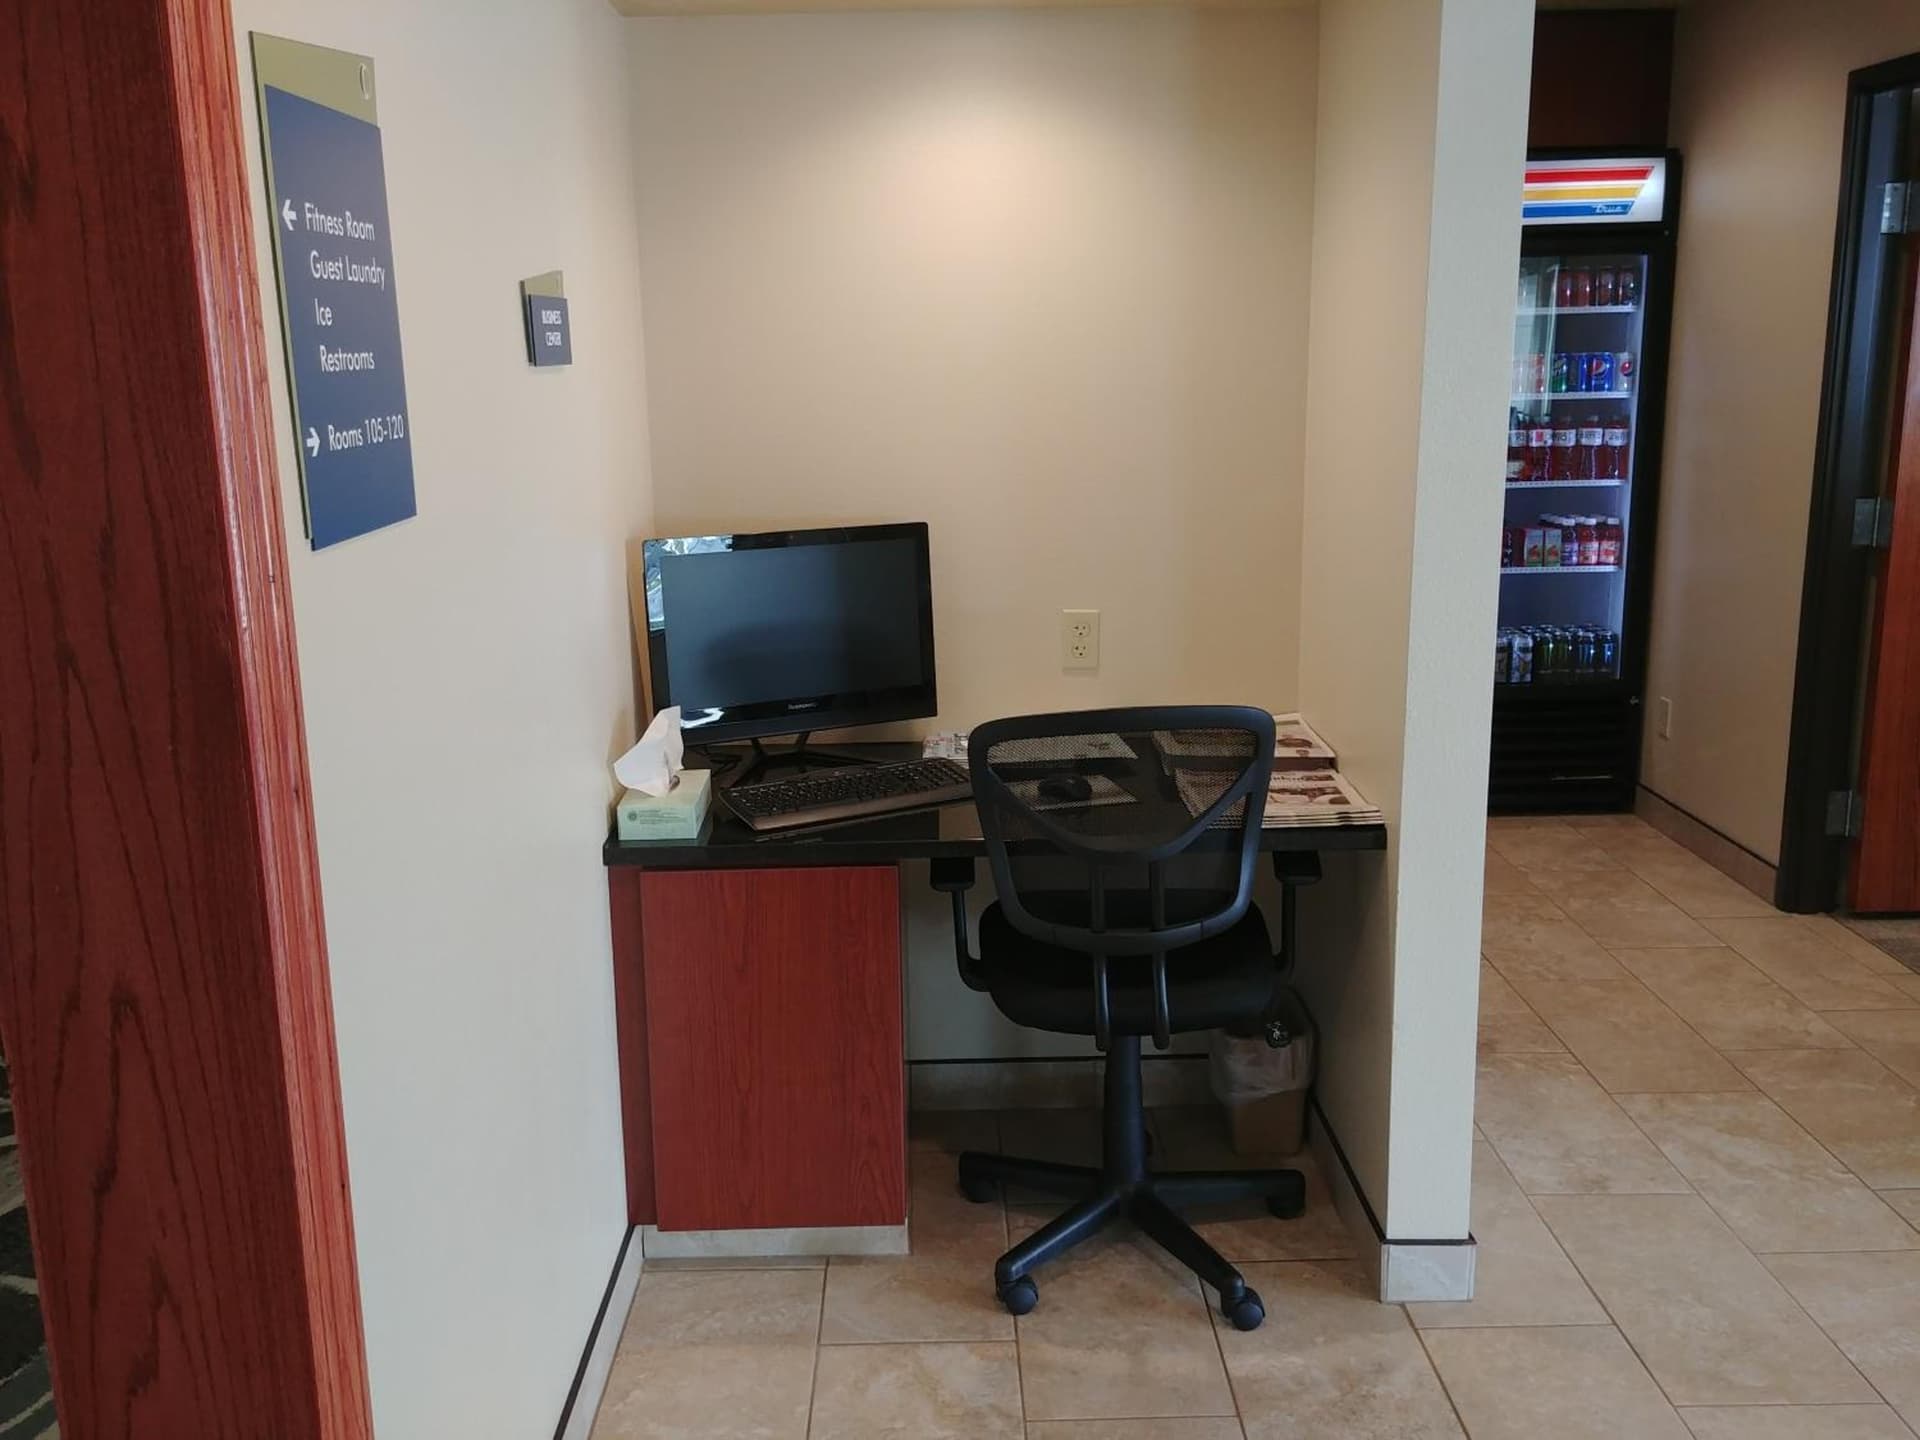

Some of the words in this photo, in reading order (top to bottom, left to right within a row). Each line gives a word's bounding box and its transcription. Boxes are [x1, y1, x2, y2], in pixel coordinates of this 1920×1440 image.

[304, 202, 344, 236] Fitness
[345, 210, 375, 241] Room
[310, 249, 343, 280] Guest
[345, 255, 385, 291] Laundry
[314, 298, 333, 326] Ice
[319, 345, 375, 372] Restrooms
[328, 424, 363, 451] Rooms
[364, 414, 404, 445] 105-120
